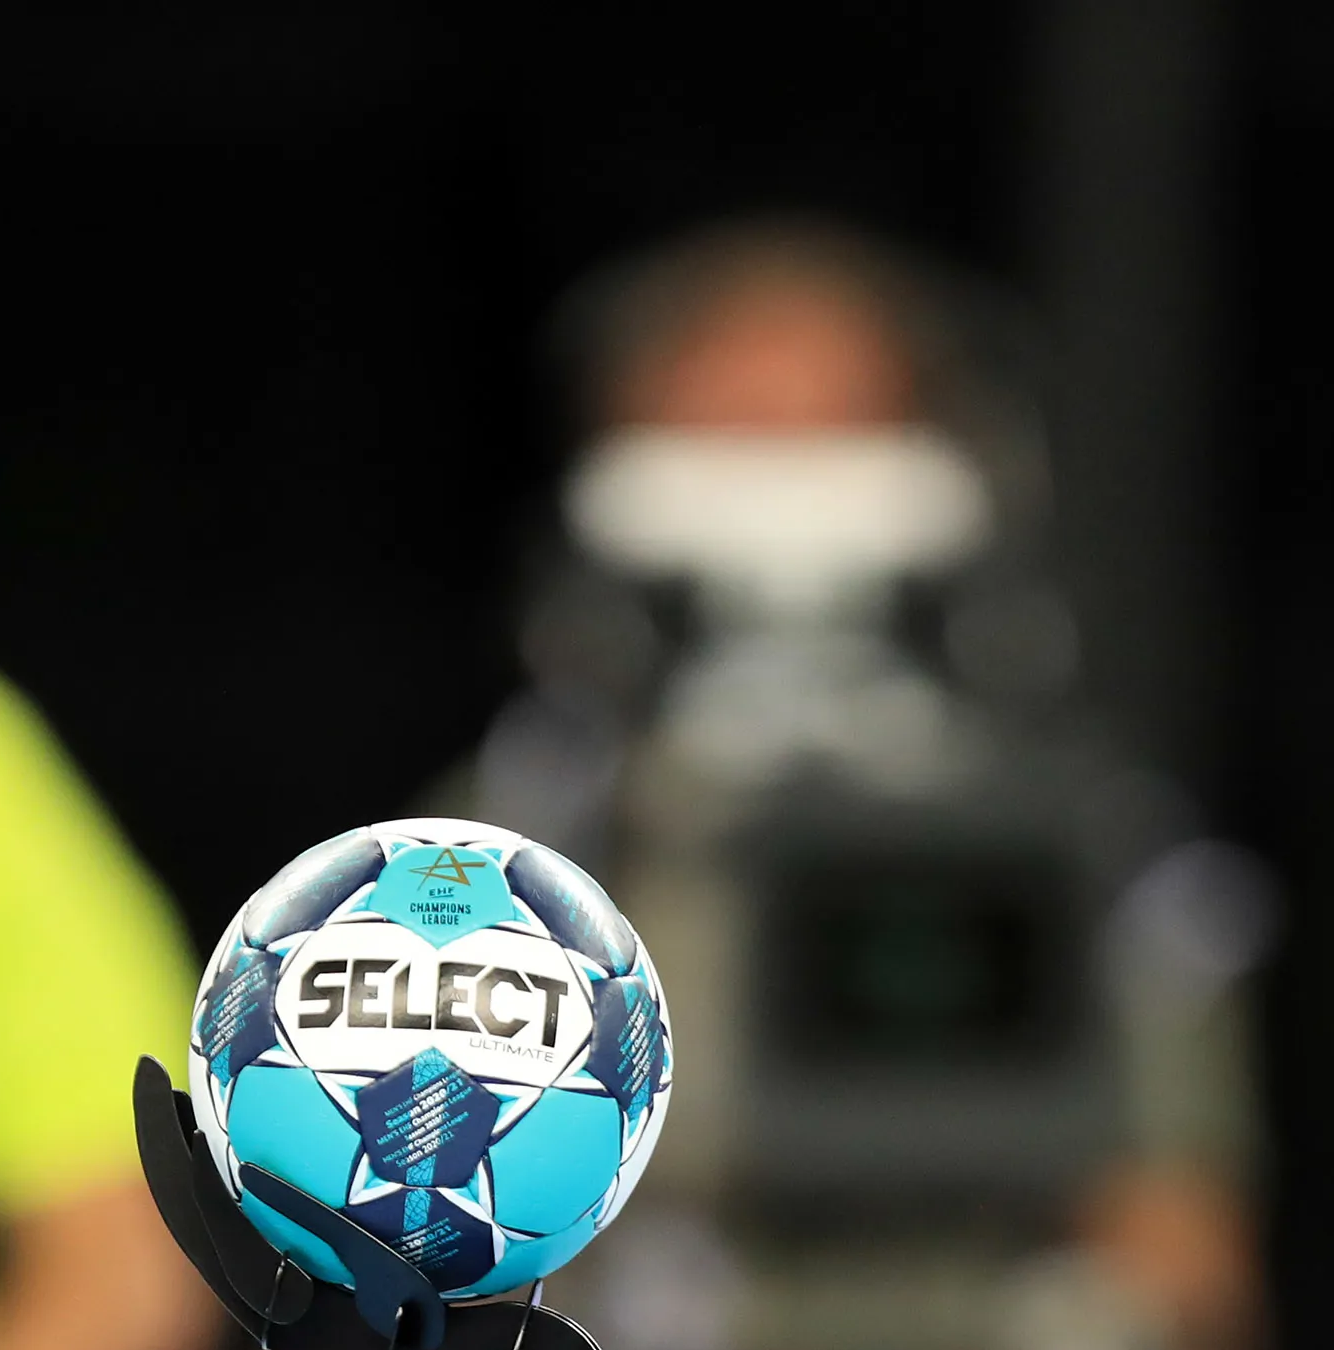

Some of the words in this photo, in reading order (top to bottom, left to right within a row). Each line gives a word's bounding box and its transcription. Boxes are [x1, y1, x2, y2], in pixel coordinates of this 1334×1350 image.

[429, 887, 454, 897] EHF
[410, 902, 472, 914] CHAMPIONS
[422, 913, 460, 925] LEAGUE
[298, 958, 568, 1048] SELECT
[470, 1037, 555, 1062] ULTIMATE
[385, 1104, 420, 1128] Season
[419, 1078, 463, 1107] 2020/21
[412, 1102, 448, 1125] Champions
[396, 1149, 422, 1166] Season
[422, 1131, 453, 1152] 2020/21
[407, 1225, 451, 1247] 2020/21
